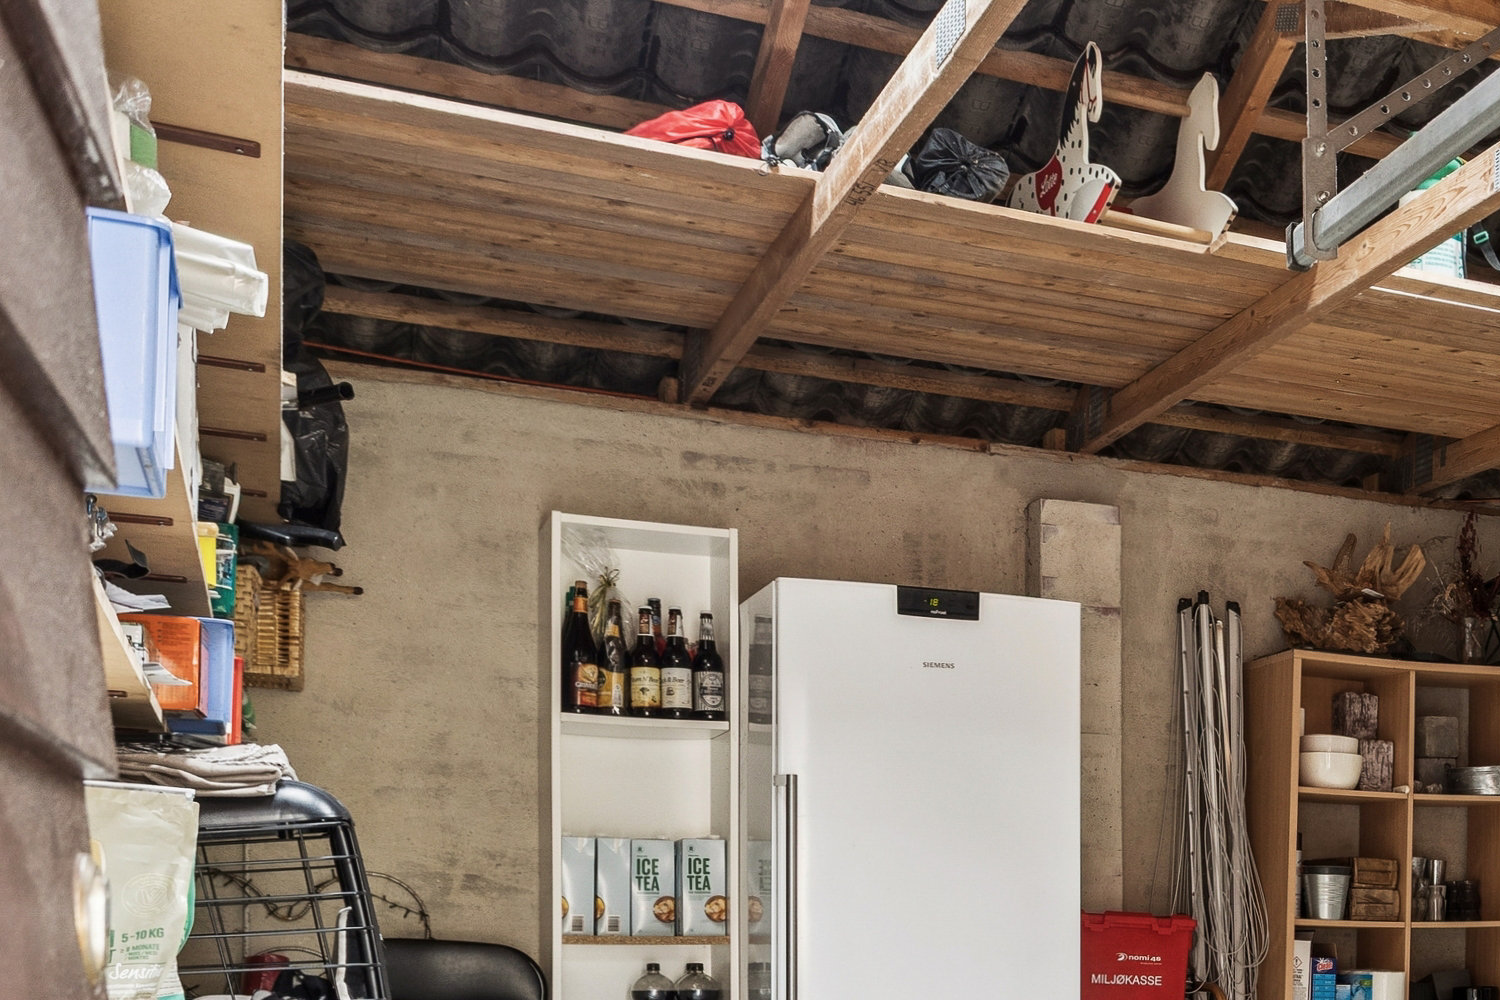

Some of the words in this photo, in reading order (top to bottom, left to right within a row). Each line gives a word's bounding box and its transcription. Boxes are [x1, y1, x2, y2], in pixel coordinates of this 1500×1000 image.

[922, 661, 955, 669] SIEMENS
[636, 858, 660, 875] ICE
[688, 857, 711, 875] ICE
[635, 876, 660, 891] TEA
[687, 875, 711, 891] TEA
[148, 927, 165, 938] KG
[1091, 973, 1162, 986] MILJØKASSE
